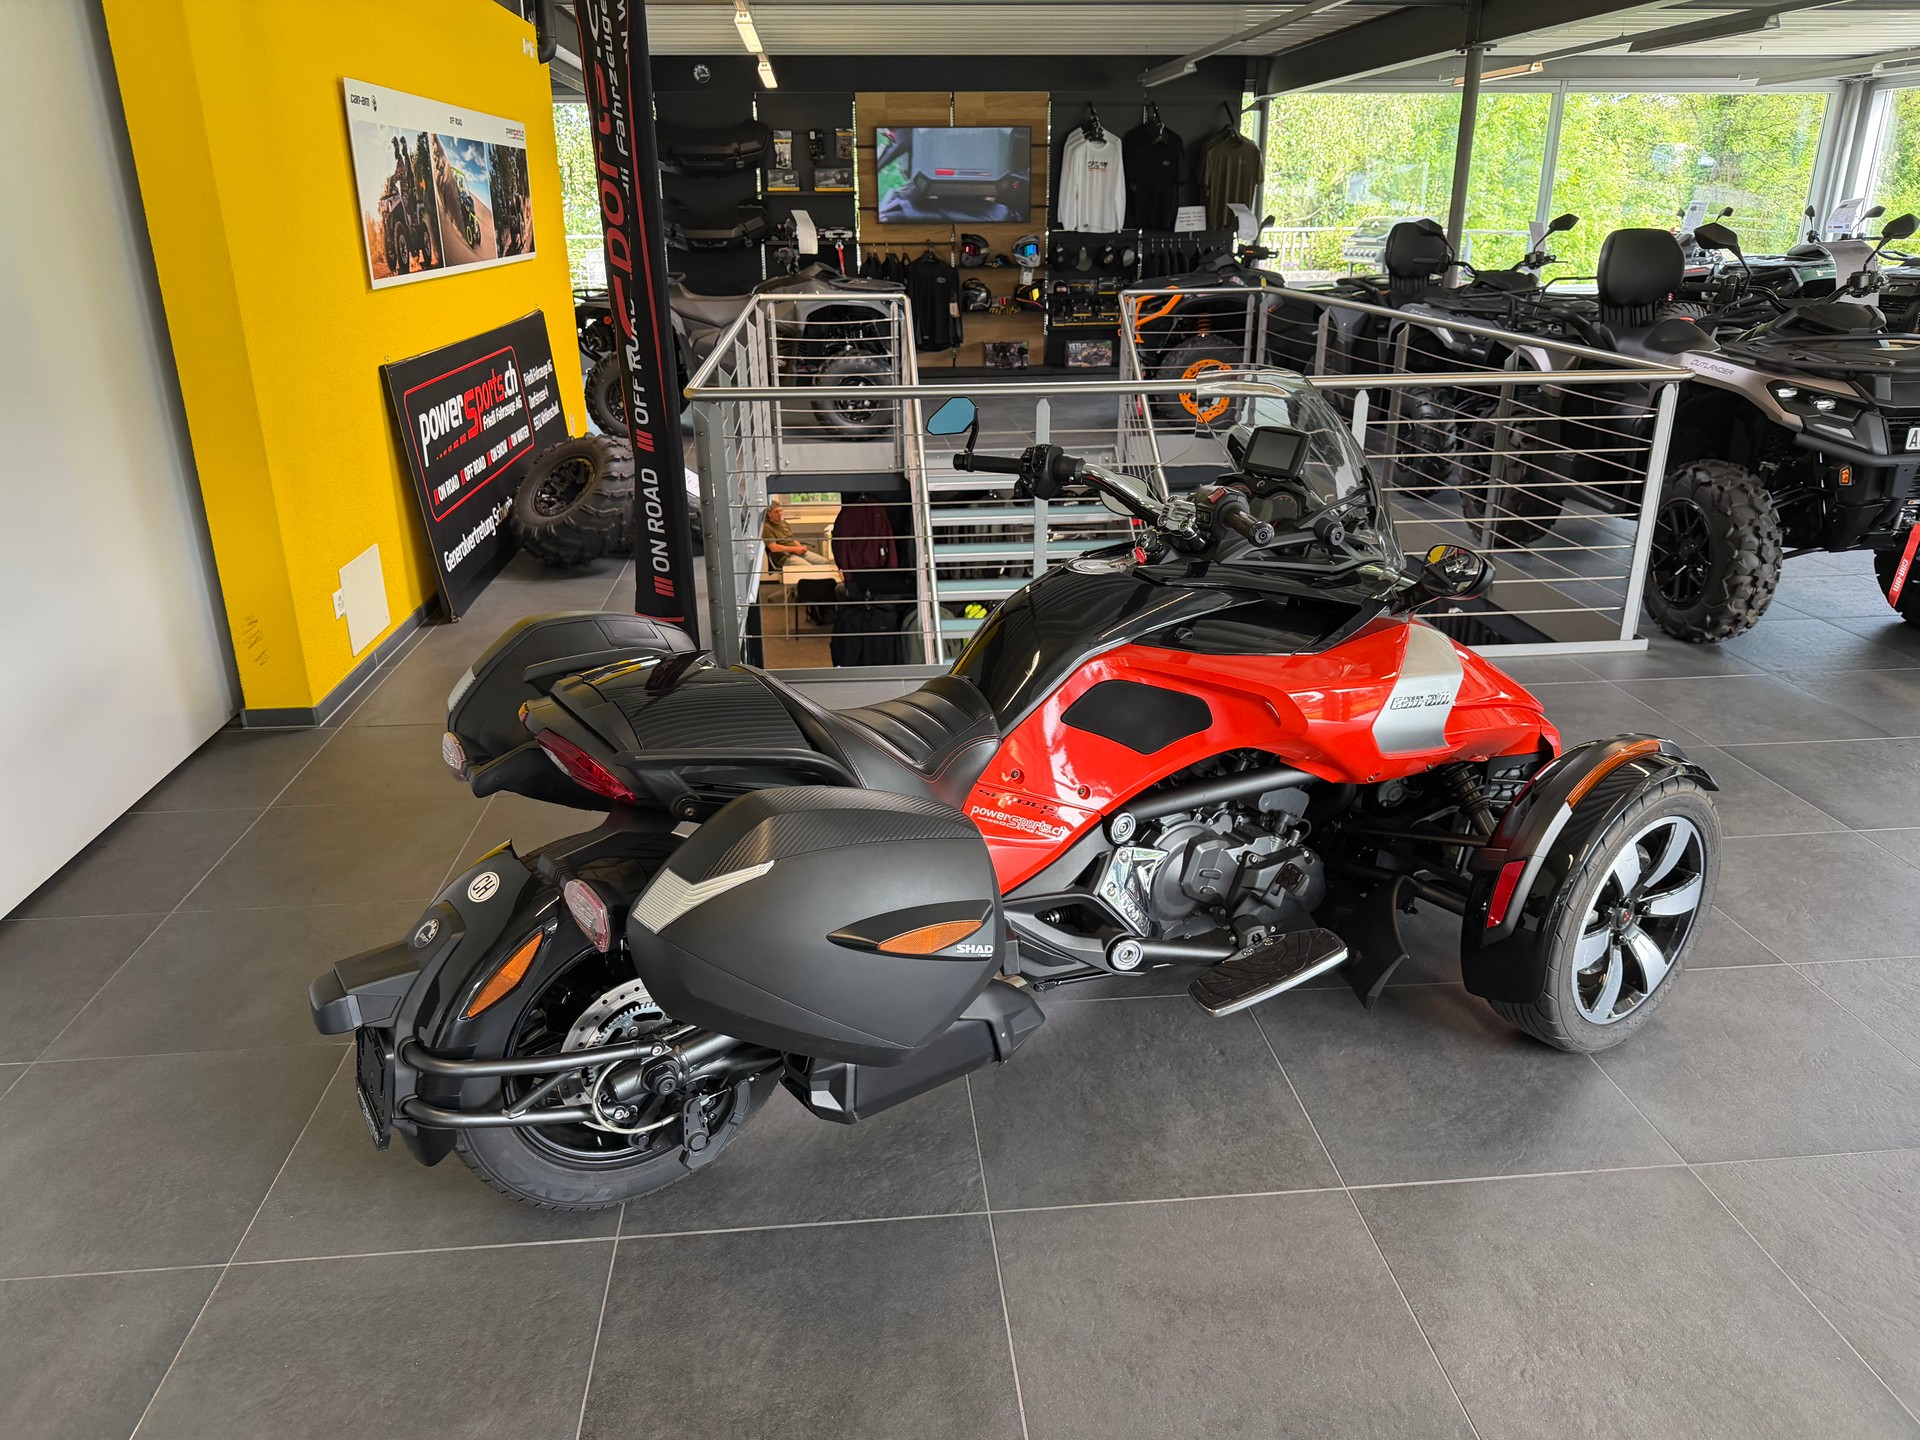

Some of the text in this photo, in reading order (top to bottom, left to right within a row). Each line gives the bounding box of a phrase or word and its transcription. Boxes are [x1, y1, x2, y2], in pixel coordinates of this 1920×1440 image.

[350, 93, 370, 107] can-am
[1690, 359, 1735, 376] OUTLANDER
[418, 360, 519, 468] powerSports.ch
[495, 401, 515, 423] Fahrzeuge
[514, 394, 523, 410] AG
[632, 378, 650, 425] OFF
[464, 455, 487, 482] OFF ROAD
[437, 474, 460, 502] ON ROAD
[641, 467, 670, 573] ON ROAD
[443, 515, 497, 573] Generalvertretung
[1892, 558, 1909, 592] can-am
[1389, 691, 1452, 710] can-am
[969, 805, 1065, 836] powerSports.ch
[472, 875, 496, 898] CH
[418, 932, 430, 943] BRP
[956, 944, 994, 954] SHAD
